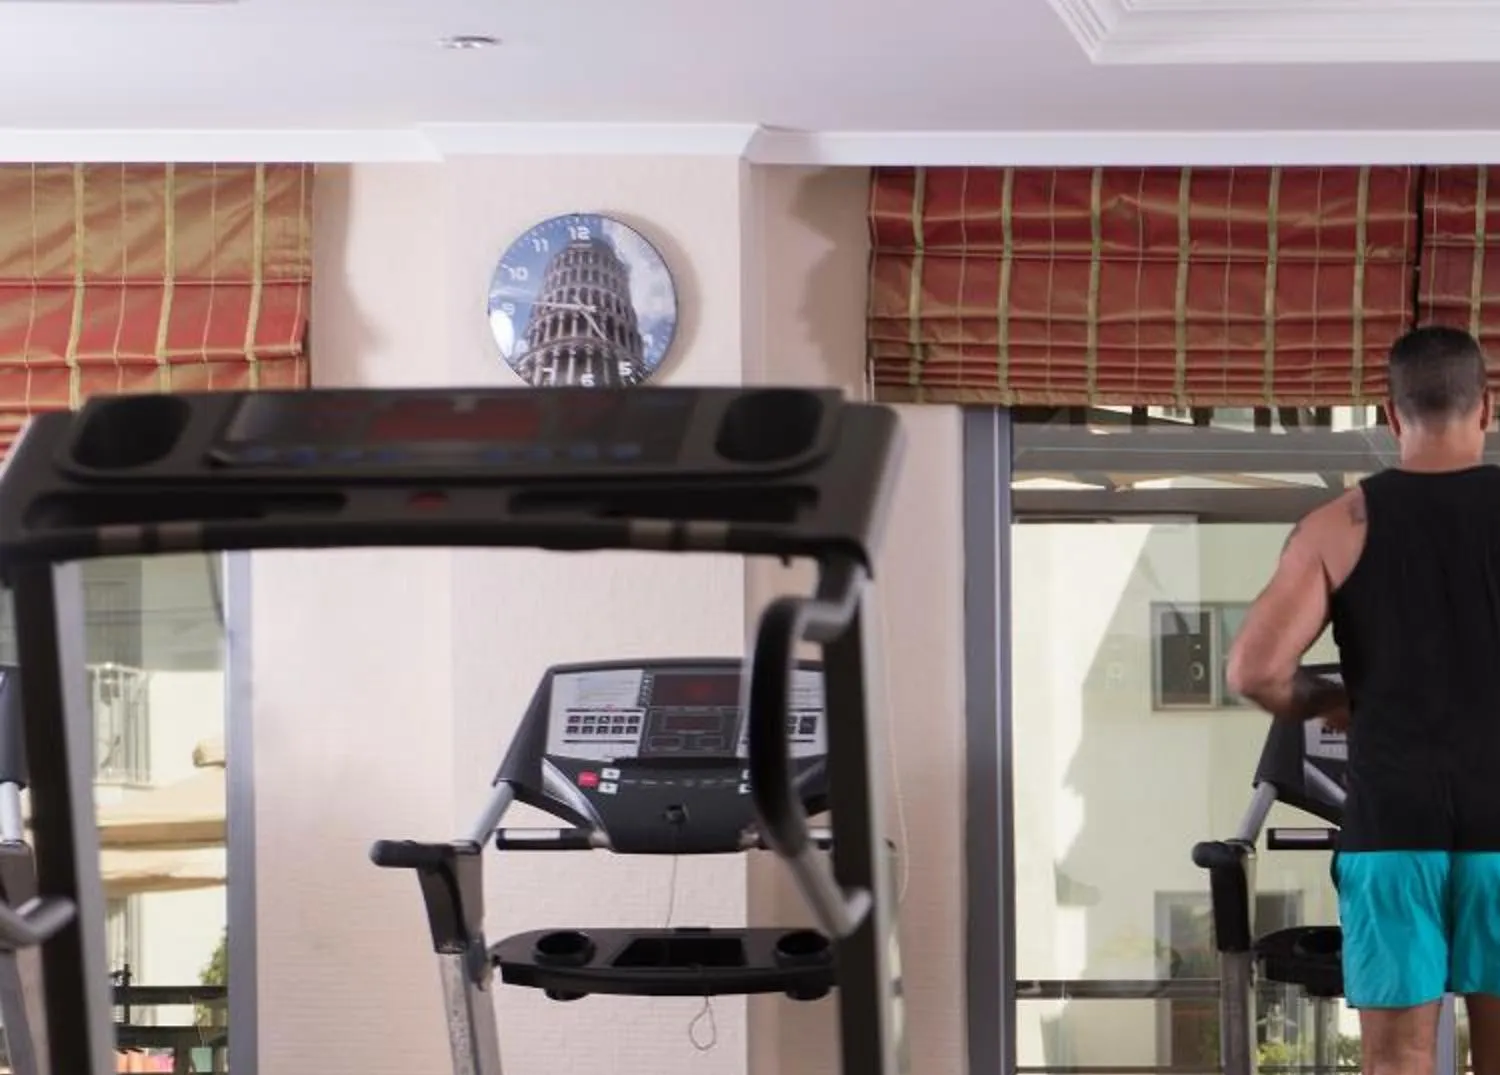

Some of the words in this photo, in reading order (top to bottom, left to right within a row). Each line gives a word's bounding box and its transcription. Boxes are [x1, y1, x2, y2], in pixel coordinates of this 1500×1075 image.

[568, 226, 590, 240] 12
[532, 238, 549, 252] 11
[509, 267, 528, 280] 10
[618, 361, 632, 375] 5
[580, 373, 595, 387] 6
